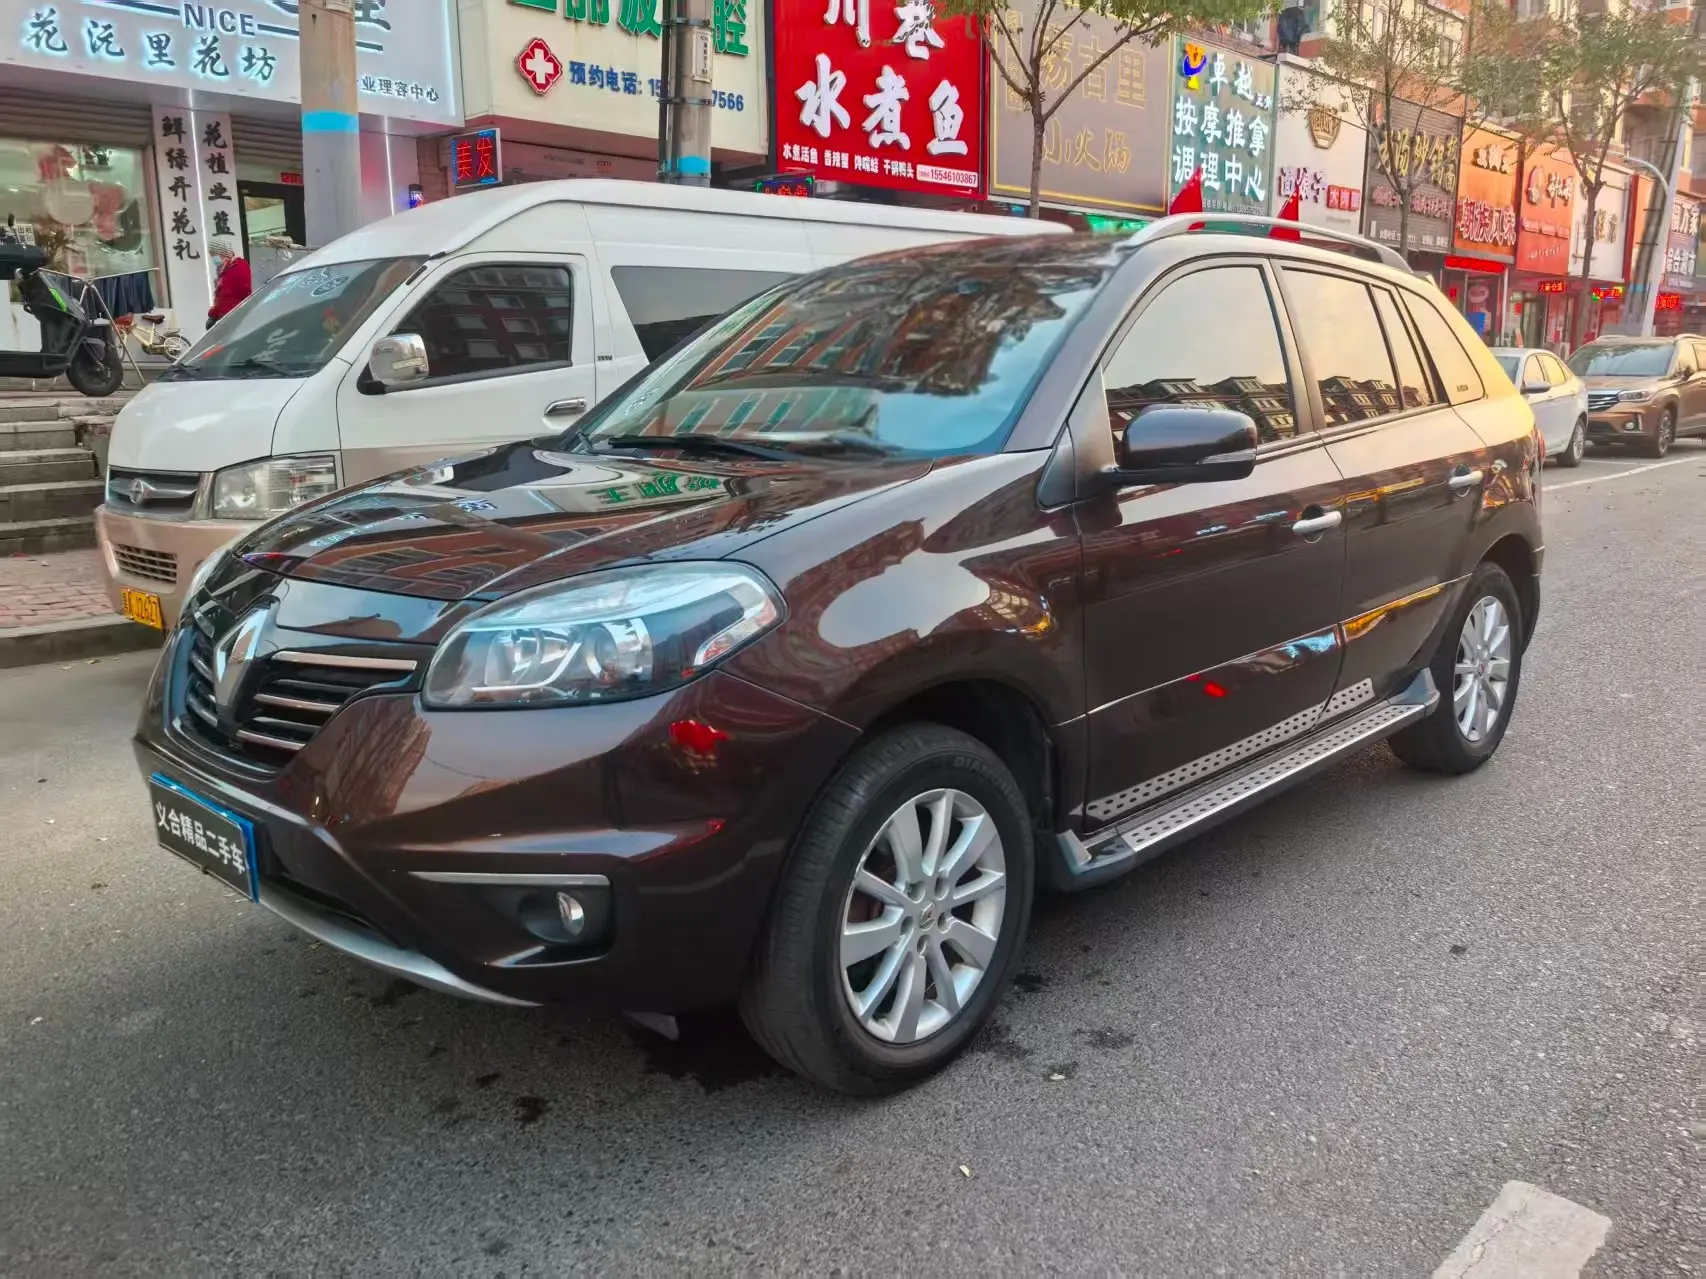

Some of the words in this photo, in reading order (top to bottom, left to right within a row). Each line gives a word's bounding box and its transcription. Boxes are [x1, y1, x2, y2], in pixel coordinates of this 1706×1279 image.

[184, 4, 256, 36] NICE
[1210, 53, 1254, 100] 卓越
[795, 53, 968, 157] 水煮鱼
[1174, 96, 1269, 157] 按摩推拿
[456, 137, 496, 181] 美发
[1173, 145, 1266, 202] 调理中心
